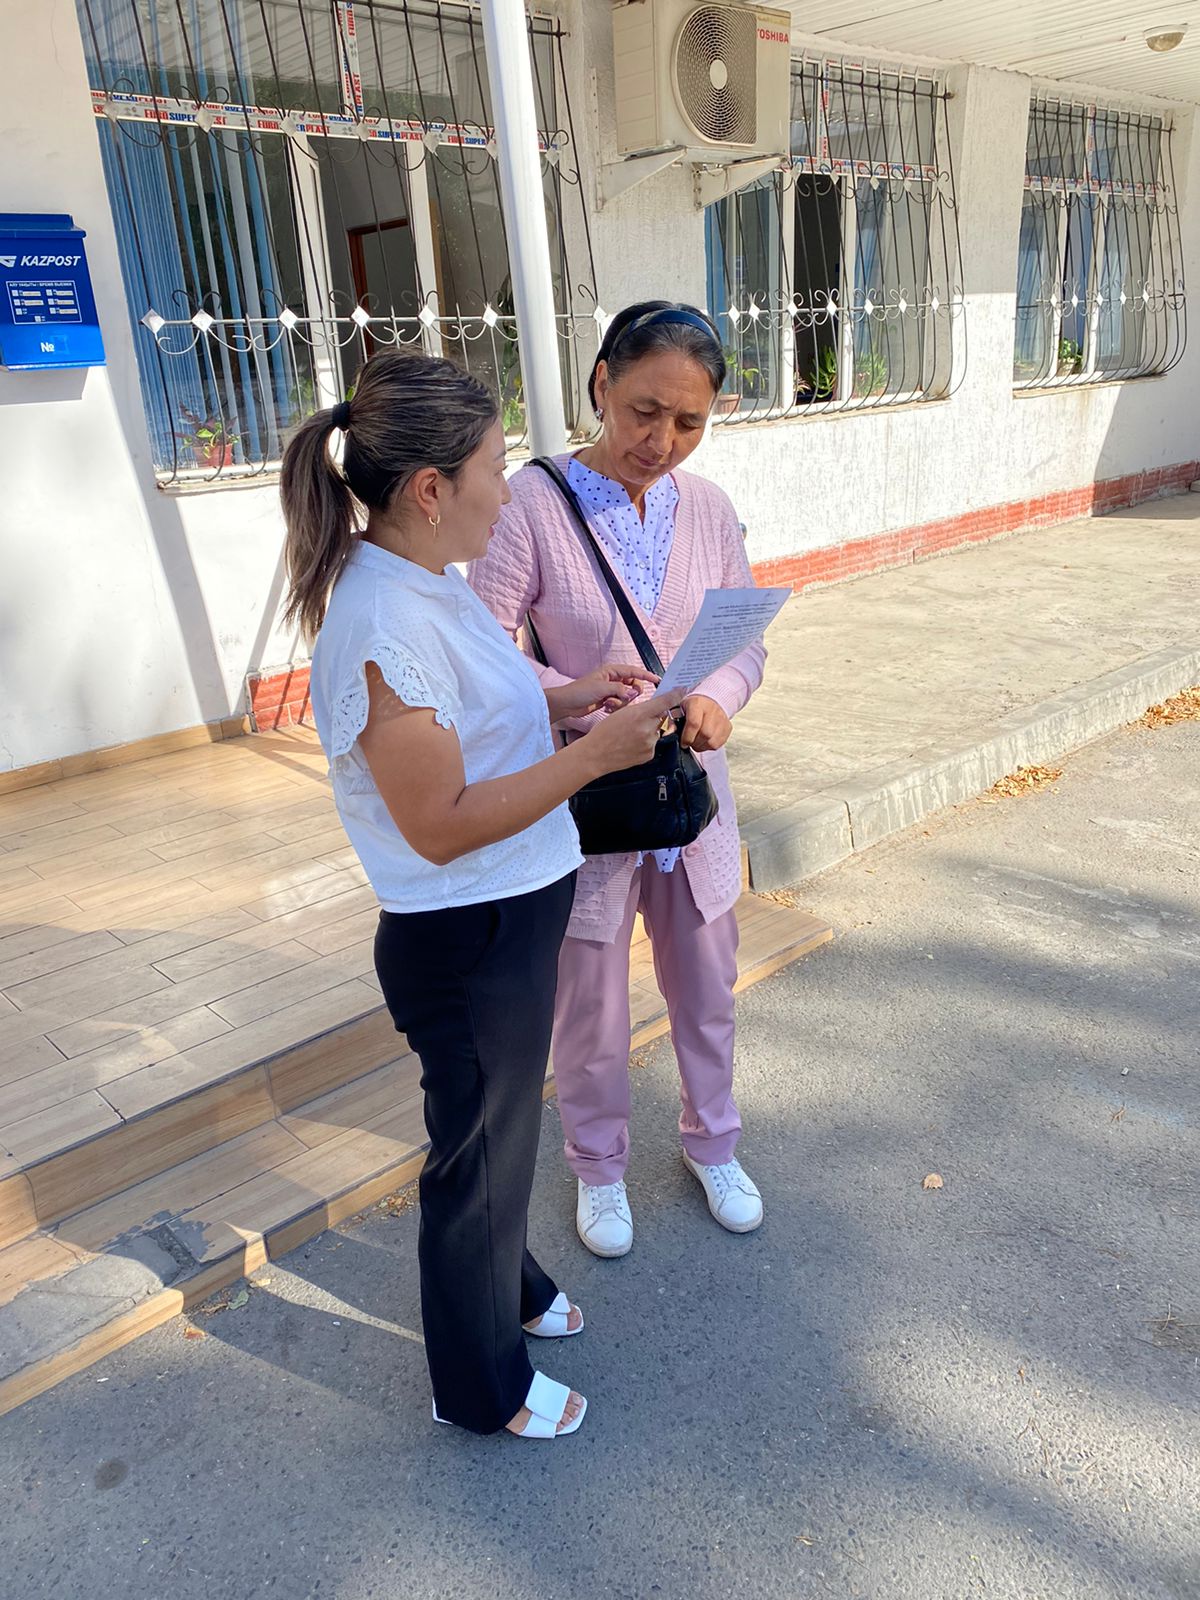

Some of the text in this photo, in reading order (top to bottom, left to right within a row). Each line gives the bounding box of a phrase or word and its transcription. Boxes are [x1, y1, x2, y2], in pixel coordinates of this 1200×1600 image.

[757, 28, 789, 44] OSHIBA
[20, 255, 82, 267] KAZPOST
[40, 341, 55, 353] №
